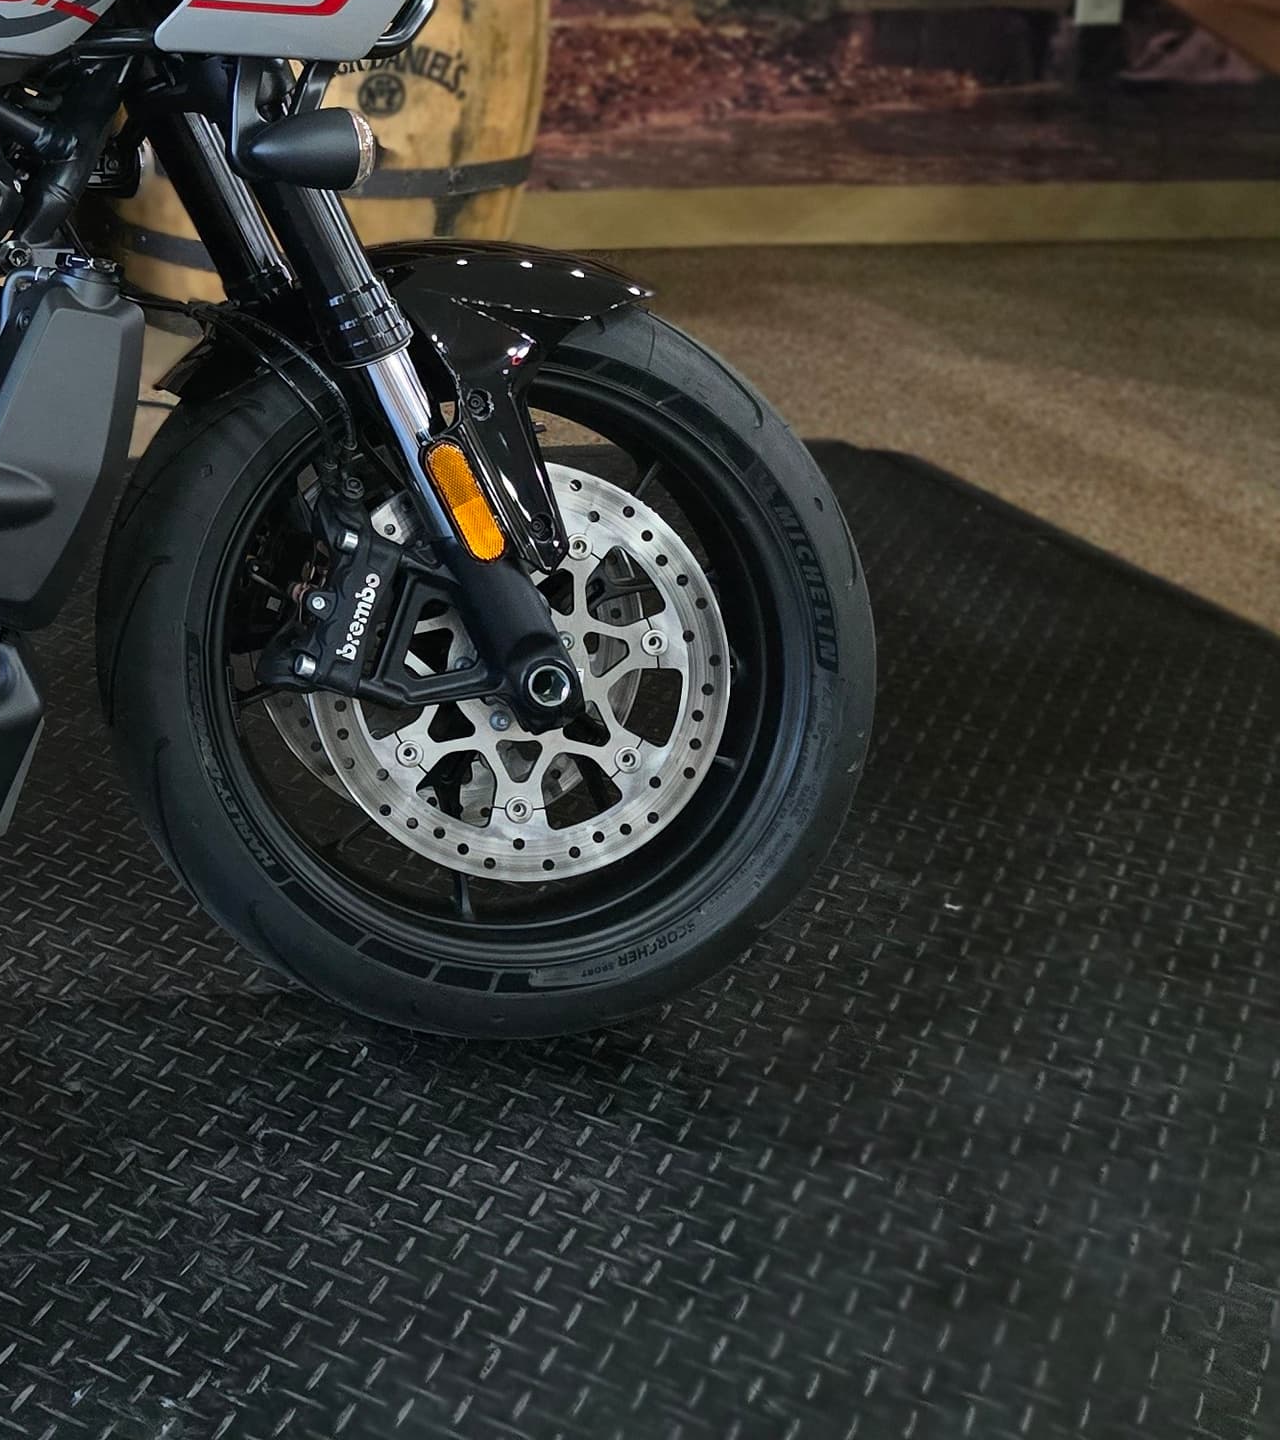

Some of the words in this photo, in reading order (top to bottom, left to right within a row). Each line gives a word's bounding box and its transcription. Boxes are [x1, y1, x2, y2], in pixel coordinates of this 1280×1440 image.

[336, 573, 381, 660] brembo
[775, 504, 837, 661] MICHELIN
[618, 922, 696, 966] SCORCHER
